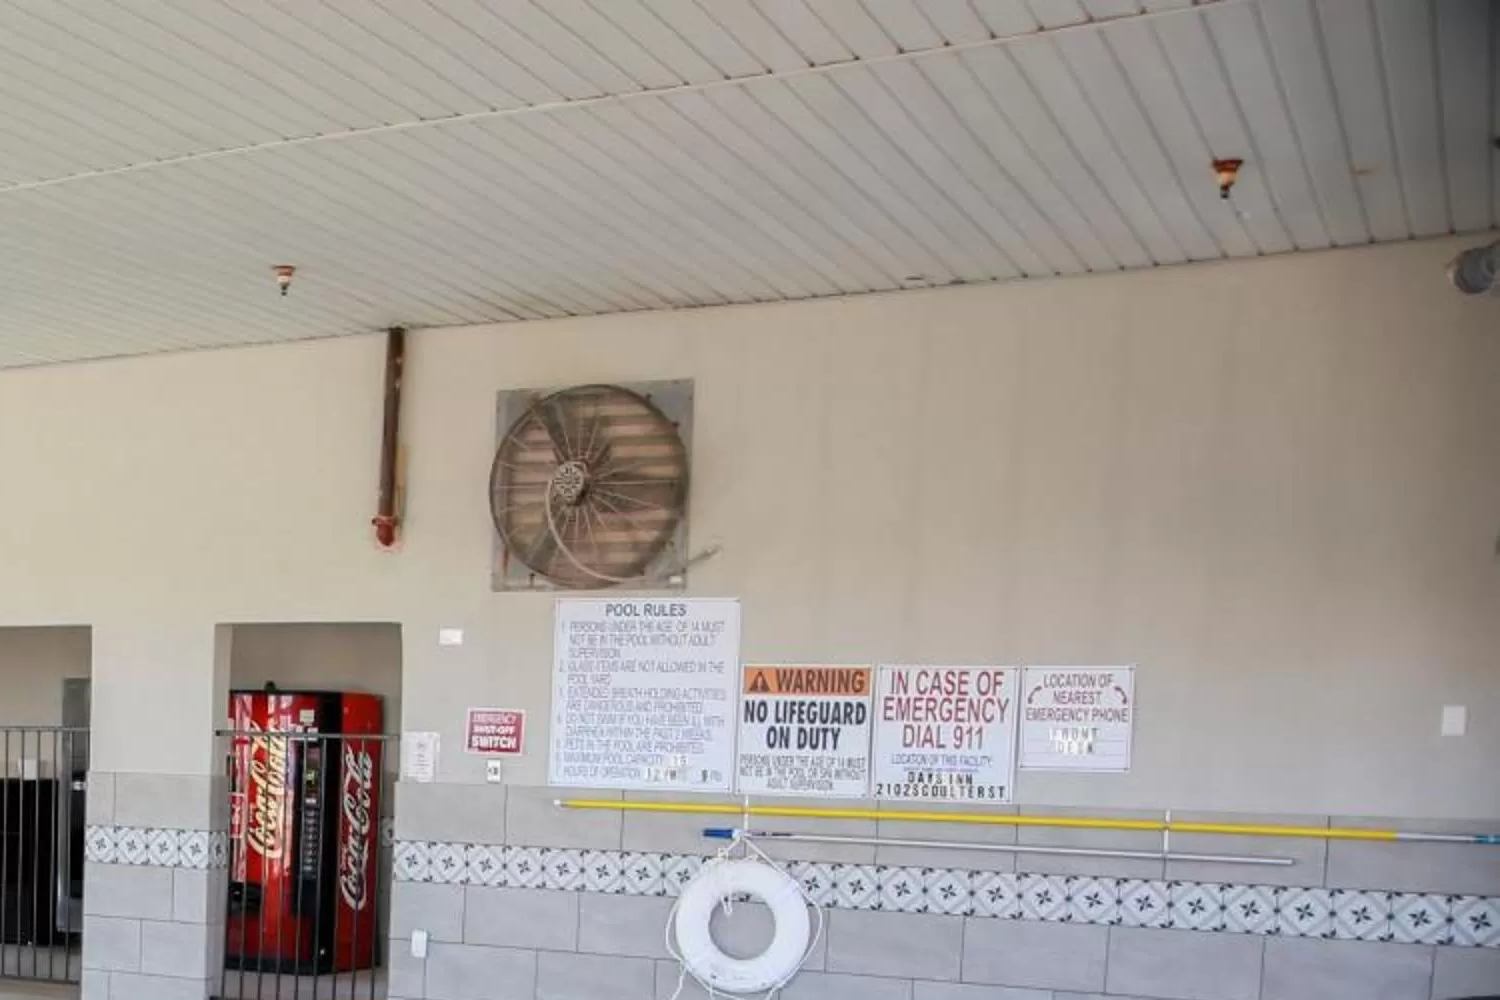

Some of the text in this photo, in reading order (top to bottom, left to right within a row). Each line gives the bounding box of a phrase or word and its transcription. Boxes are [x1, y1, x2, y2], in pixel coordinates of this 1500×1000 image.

[605, 603, 687, 617] POOL RULES
[775, 668, 865, 694] WARNING
[890, 670, 1005, 696] IN CASE OF
[1043, 673, 1115, 688] LOCATION OF
[883, 697, 1010, 723] EMERGENCY
[1053, 690, 1102, 705] NEAREST
[744, 700, 867, 725] NO LIFEGUARD
[1026, 708, 1129, 723] EMERGENCY PHONE
[472, 736, 517, 749] SWITCH
[766, 725, 841, 751] ON DUTY
[902, 724, 983, 750] DIAL 911
[247, 718, 289, 859] Coca-Cola
[907, 771, 944, 785] DAYS
[340, 742, 373, 911] Coca-Cola
